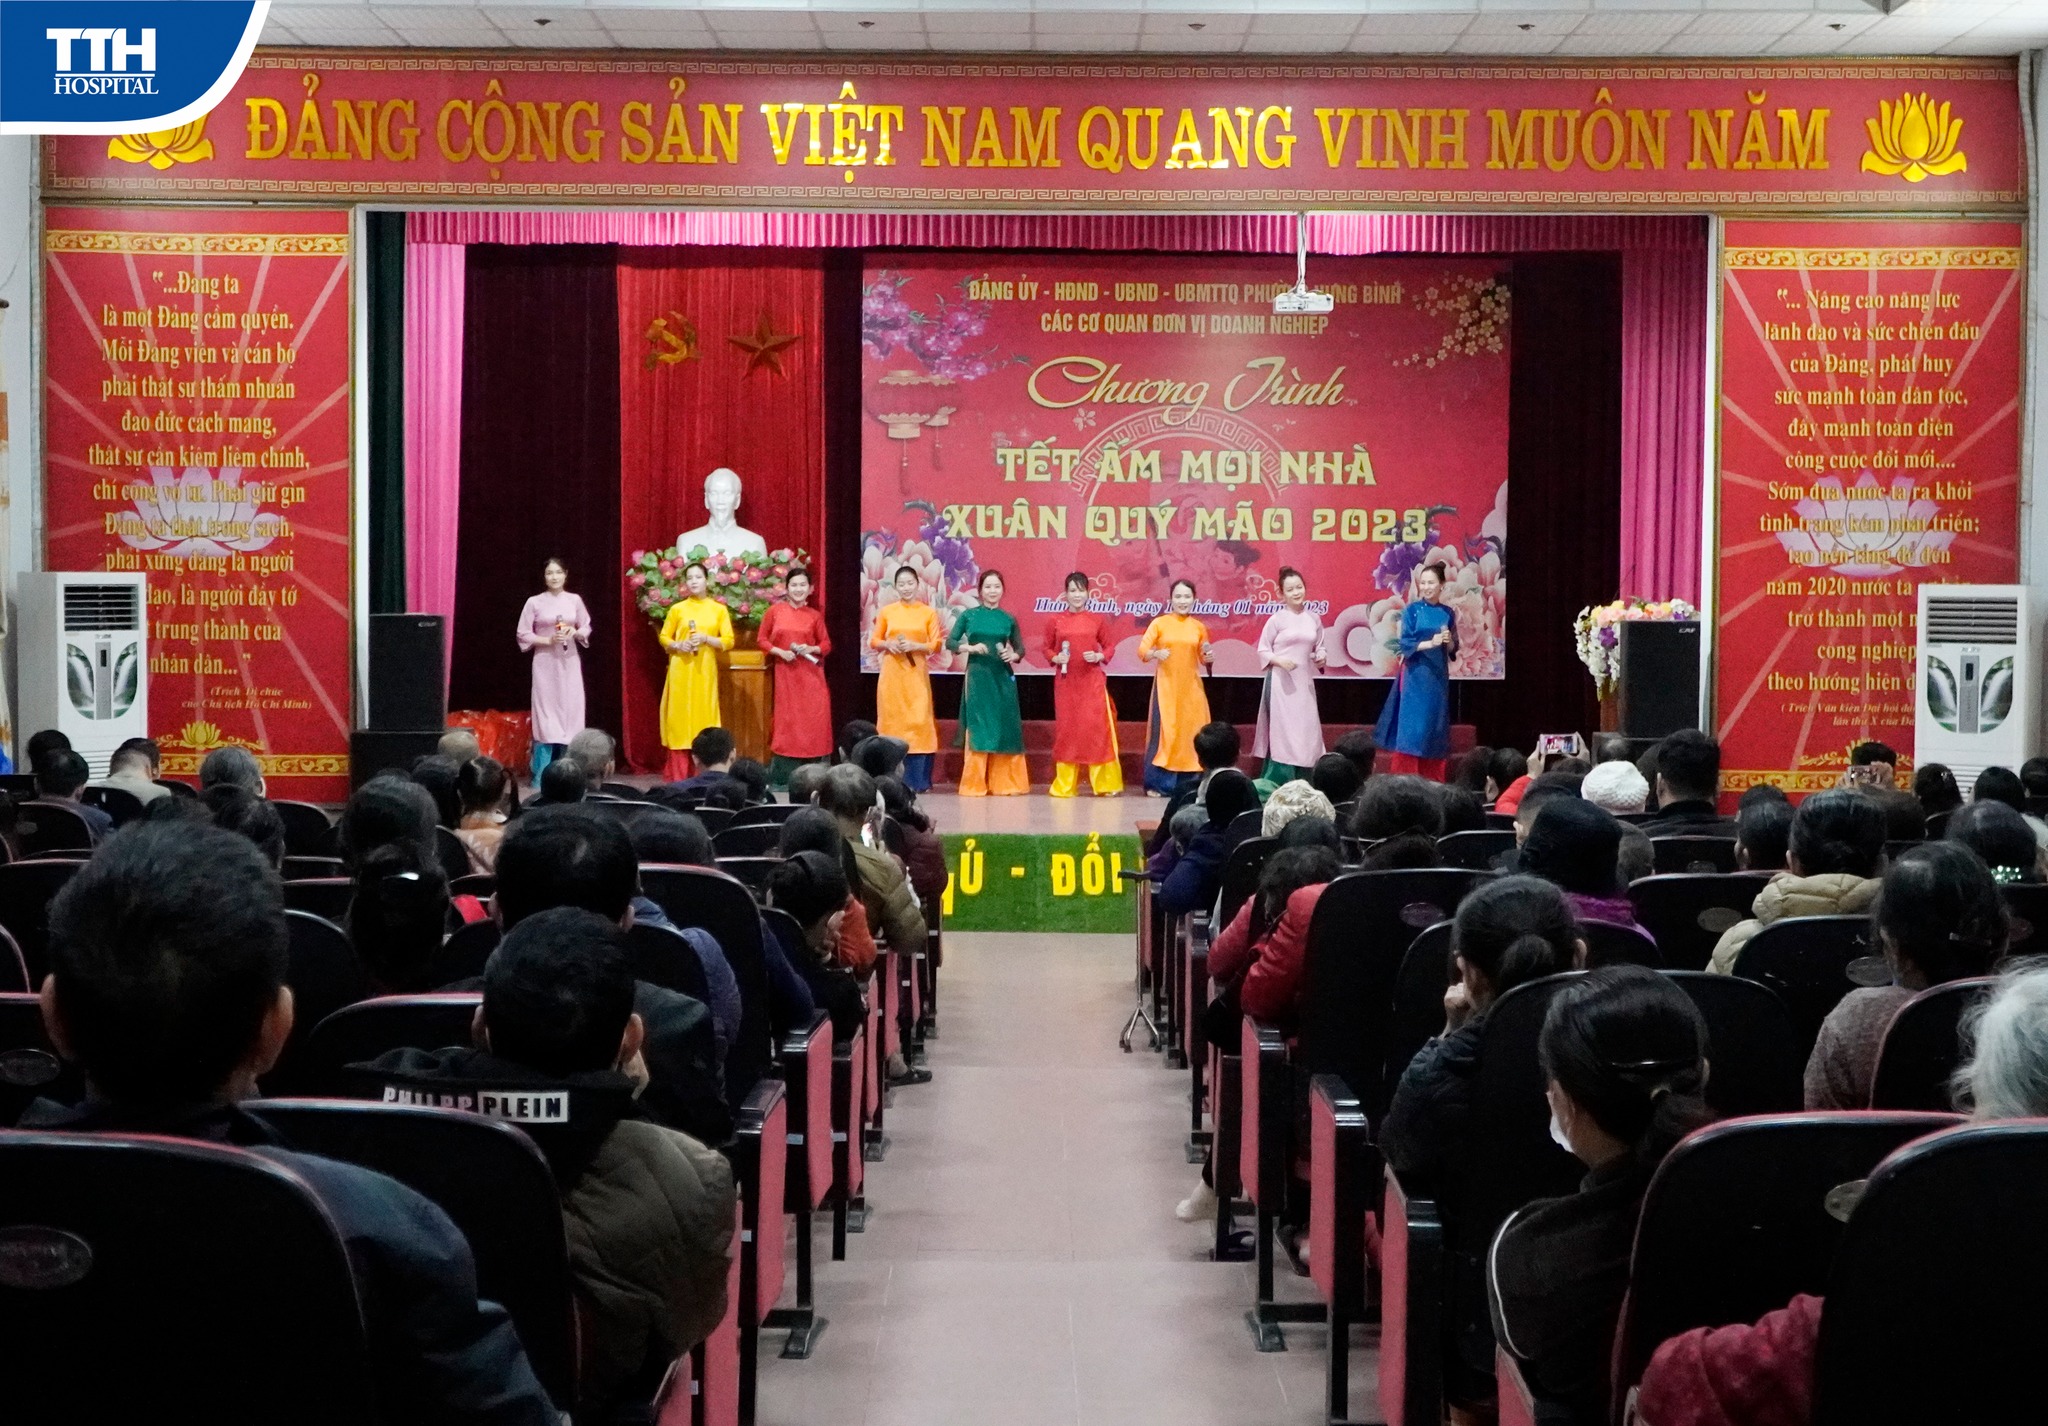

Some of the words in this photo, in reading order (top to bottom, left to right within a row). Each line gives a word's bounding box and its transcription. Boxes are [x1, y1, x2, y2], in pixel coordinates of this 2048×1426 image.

[245, 74, 421, 163] ĐẢNG
[437, 78, 605, 180] CỘNG
[621, 76, 743, 166] SẢN
[760, 81, 903, 183] VIỆT
[920, 106, 1061, 169] NAM
[1077, 106, 1297, 173] QUANG
[1313, 107, 1471, 170] VINH
[1486, 87, 1672, 173] MUÔN
[1687, 89, 1831, 172] NĂM
[224, 274, 239, 294] ta
[969, 273, 1013, 301] ĐẢNG
[1018, 273, 1039, 300] ỦY
[1054, 281, 1098, 302] HĐND
[1114, 283, 1159, 302] UBND
[1174, 283, 1239, 304] UBMTTQ
[1363, 280, 1402, 304] BÌNH
[1806, 289, 1851, 314] Nâng
[1855, 294, 1884, 309] cao
[1889, 291, 1930, 314] năng
[1935, 289, 1960, 312] lực
[103, 304, 118, 327] là
[158, 304, 198, 334] Đảng
[204, 305, 236, 329] cầm
[1041, 309, 1072, 332] CÁC
[1078, 311, 1100, 333] CƠ
[1104, 313, 1148, 335] QUAN
[1153, 312, 1186, 333] ĐƠN
[1191, 314, 1206, 337] VỊ
[1211, 315, 1265, 334] DOANH
[1764, 321, 1801, 341] lãnh
[1807, 322, 1837, 344] đạo
[1843, 322, 1861, 341] và
[1867, 322, 1894, 341] sức
[1899, 320, 1943, 341] chiến
[1949, 319, 1979, 341] đấu
[185, 340, 217, 363] viên
[222, 341, 239, 363] và
[244, 341, 271, 364] cán
[277, 341, 296, 370] bộ
[1790, 351, 1819, 373] của
[1879, 353, 1917, 377] phát
[1923, 353, 1953, 377] huy
[142, 376, 173, 403] thật
[178, 379, 196, 403] sự
[201, 374, 240, 398] thấm
[1027, 355, 1209, 425] Chương
[1224, 356, 1346, 412] Trình
[1774, 386, 1801, 405] sức
[1807, 385, 1853, 410] mạnh
[1860, 385, 1896, 405] toàn
[1902, 386, 1932, 405] dân
[121, 409, 150, 437] đạo
[154, 410, 183, 433] đức
[187, 411, 223, 433] cách
[228, 415, 276, 439] mạng,
[1824, 418, 1870, 441] mạnh
[1876, 417, 1913, 437] toàn
[125, 446, 142, 471] sự
[261, 445, 310, 471] chính,
[996, 438, 1080, 484] TẾT
[1180, 449, 1262, 491] MỌI
[1280, 444, 1378, 486] NHÀ
[1830, 450, 1868, 473] cuộc
[93, 478, 117, 500] chí
[281, 481, 305, 508] gìn
[1768, 480, 1804, 500] Sớm
[1891, 484, 1908, 500] ta
[1913, 485, 1930, 500] ra
[1935, 479, 1972, 500] khỏi
[151, 518, 166, 536] ta
[943, 497, 1066, 539] XUÂN
[1085, 498, 1177, 548] QUÝ
[1192, 500, 1294, 542] MÃO
[1311, 507, 1429, 543] 2023
[1760, 512, 1793, 532] tình
[1799, 514, 1845, 537] trạng
[1933, 508, 1980, 533] triển;
[231, 550, 246, 572] là
[250, 549, 294, 577] người
[181, 583, 195, 606] là
[200, 583, 243, 611] người
[281, 585, 298, 607] tớ
[1807, 577, 1847, 596] 2020
[1852, 578, 1892, 596] nước
[1897, 580, 1912, 596] ta
[1124, 597, 1163, 617] ngày
[1233, 600, 1251, 615] 01
[1788, 607, 1814, 628] trở
[1818, 608, 1866, 627] thành
[155, 619, 200, 646] trung
[204, 618, 249, 641] thành
[254, 616, 282, 641] của
[1767, 671, 1804, 691] theo
[1809, 672, 1860, 694] hướng
[482, 1096, 561, 1119] PLEIN
